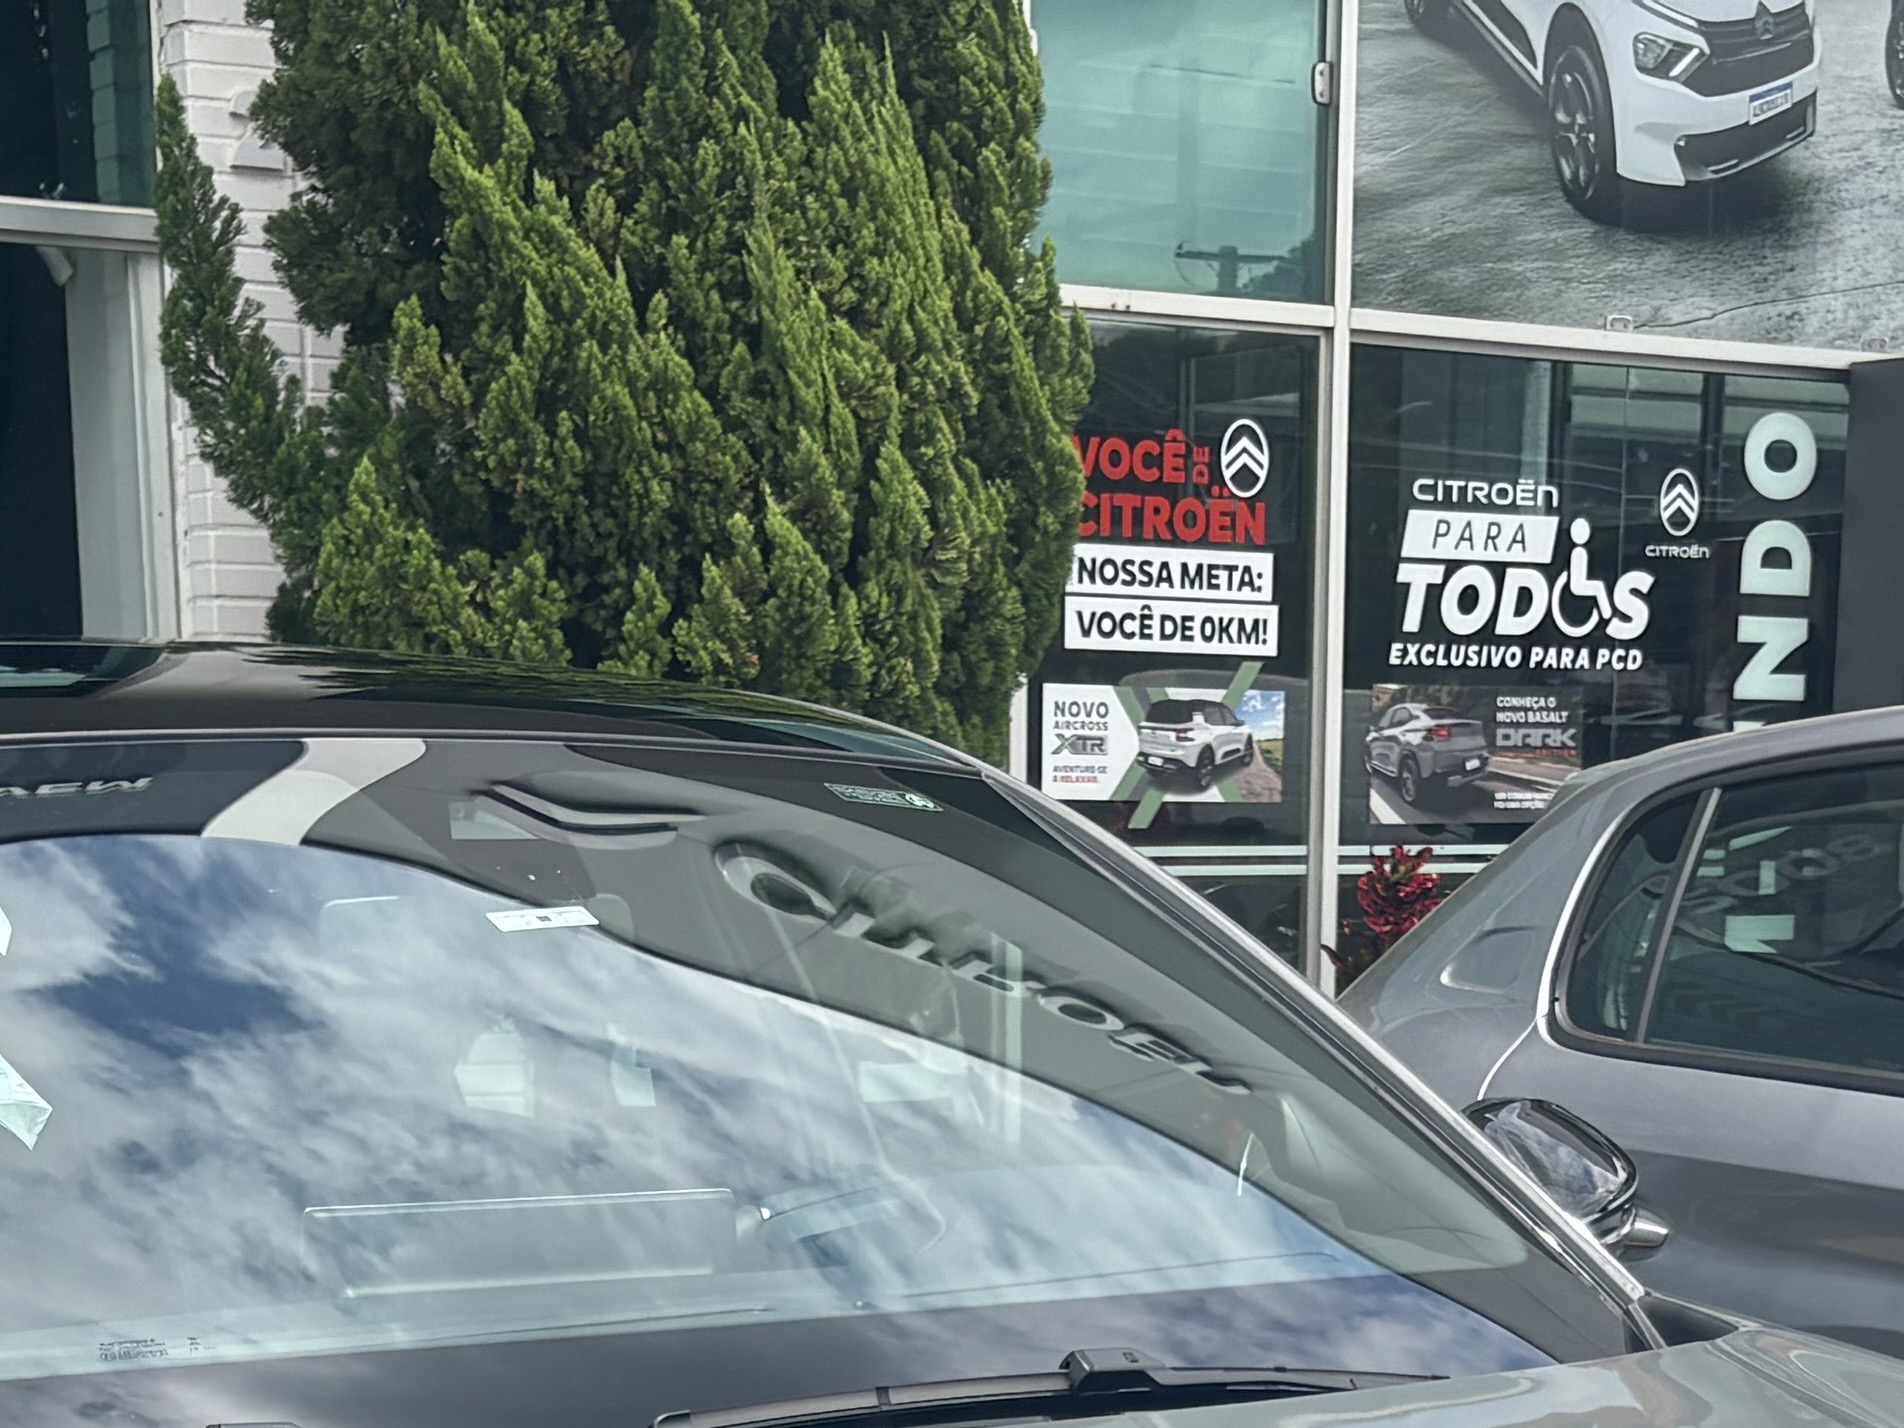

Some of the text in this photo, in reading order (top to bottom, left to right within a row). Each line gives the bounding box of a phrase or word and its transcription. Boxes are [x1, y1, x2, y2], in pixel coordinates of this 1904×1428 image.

[1072, 428, 1186, 484] VOCÊ
[1192, 446, 1210, 485] DE
[1412, 478, 1560, 508] CITROËN
[1432, 518, 1527, 553] PARA
[1077, 556, 1264, 593] NOSSA META:
[1076, 604, 1154, 642] VOCÊ
[1159, 613, 1195, 643] DE
[1388, 642, 1644, 671] EXCLUSIVO PARA PCD
[1053, 700, 1110, 720] NOVO
[1496, 711, 1569, 724] NOVO BASALT
[1053, 720, 1109, 732] AIRCROSS
[1051, 733, 1108, 756] XTR
